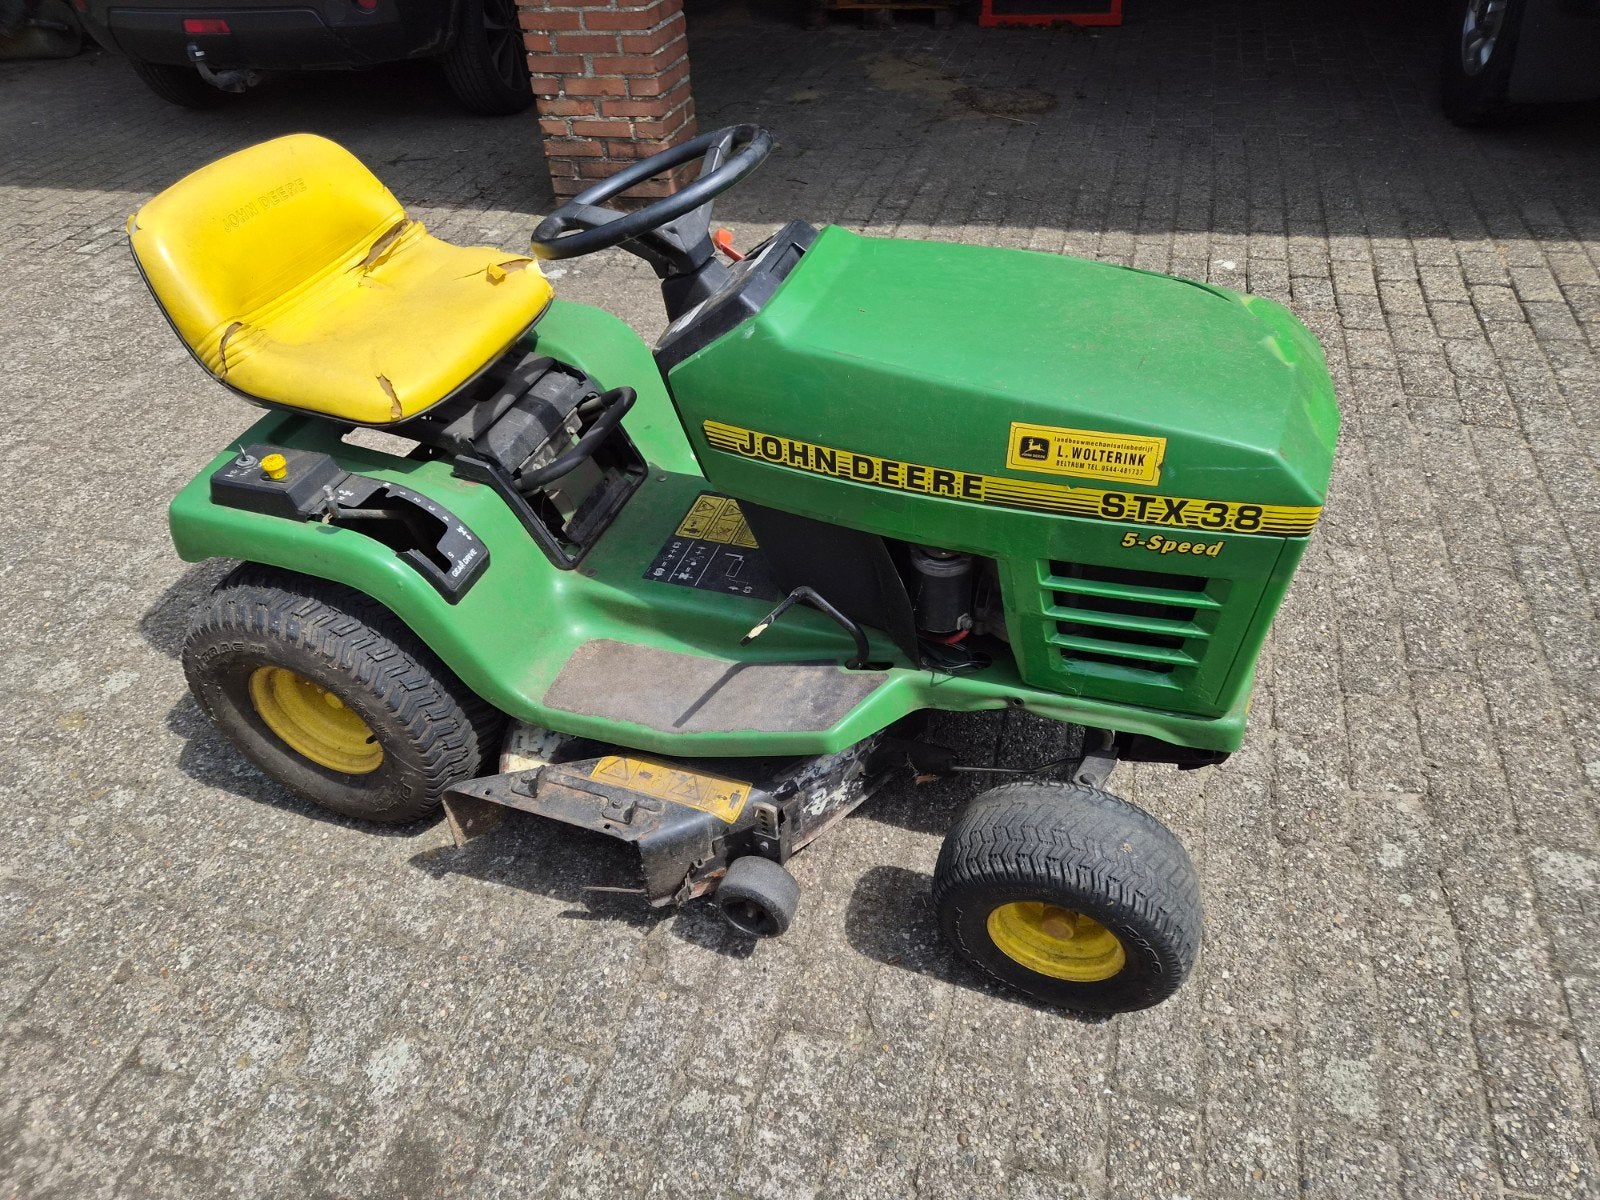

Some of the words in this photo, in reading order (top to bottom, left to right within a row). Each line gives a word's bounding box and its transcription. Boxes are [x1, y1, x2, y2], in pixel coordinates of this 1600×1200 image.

[222, 202, 259, 233] JOHN
[258, 177, 307, 209] DEERE
[738, 432, 837, 474] JOHN
[851, 454, 984, 499] DEERE
[1055, 459, 1085, 469] BELTRUM
[1057, 445, 1069, 458] L.
[1072, 447, 1147, 467] WOLTERINK
[1100, 493, 1189, 524] STX
[1200, 502, 1263, 530] 38
[1121, 532, 1225, 558] 5-Speed
[451, 561, 467, 578] GEAR
[462, 548, 477, 565] DRIVE
